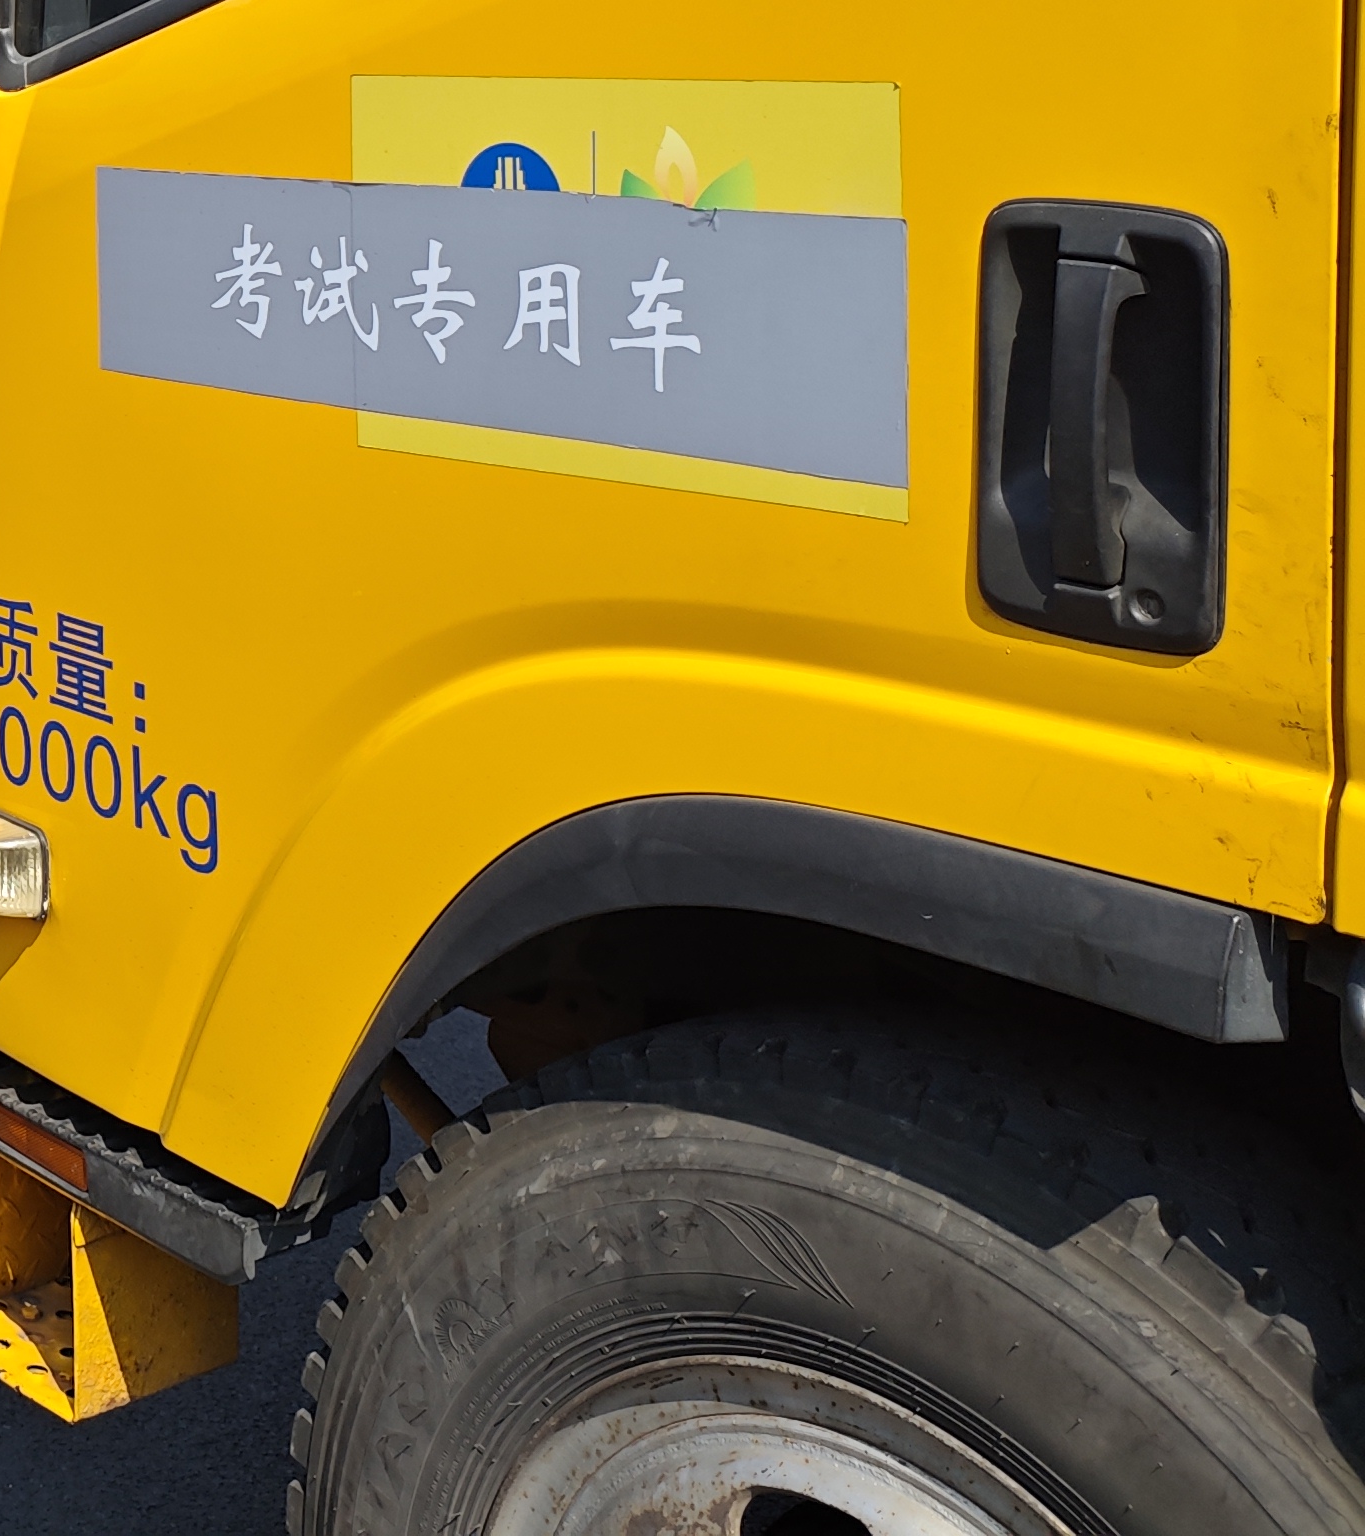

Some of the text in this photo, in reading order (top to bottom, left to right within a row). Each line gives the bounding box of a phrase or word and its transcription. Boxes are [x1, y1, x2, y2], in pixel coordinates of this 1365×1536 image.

[211, 223, 701, 393] 考试专用车
